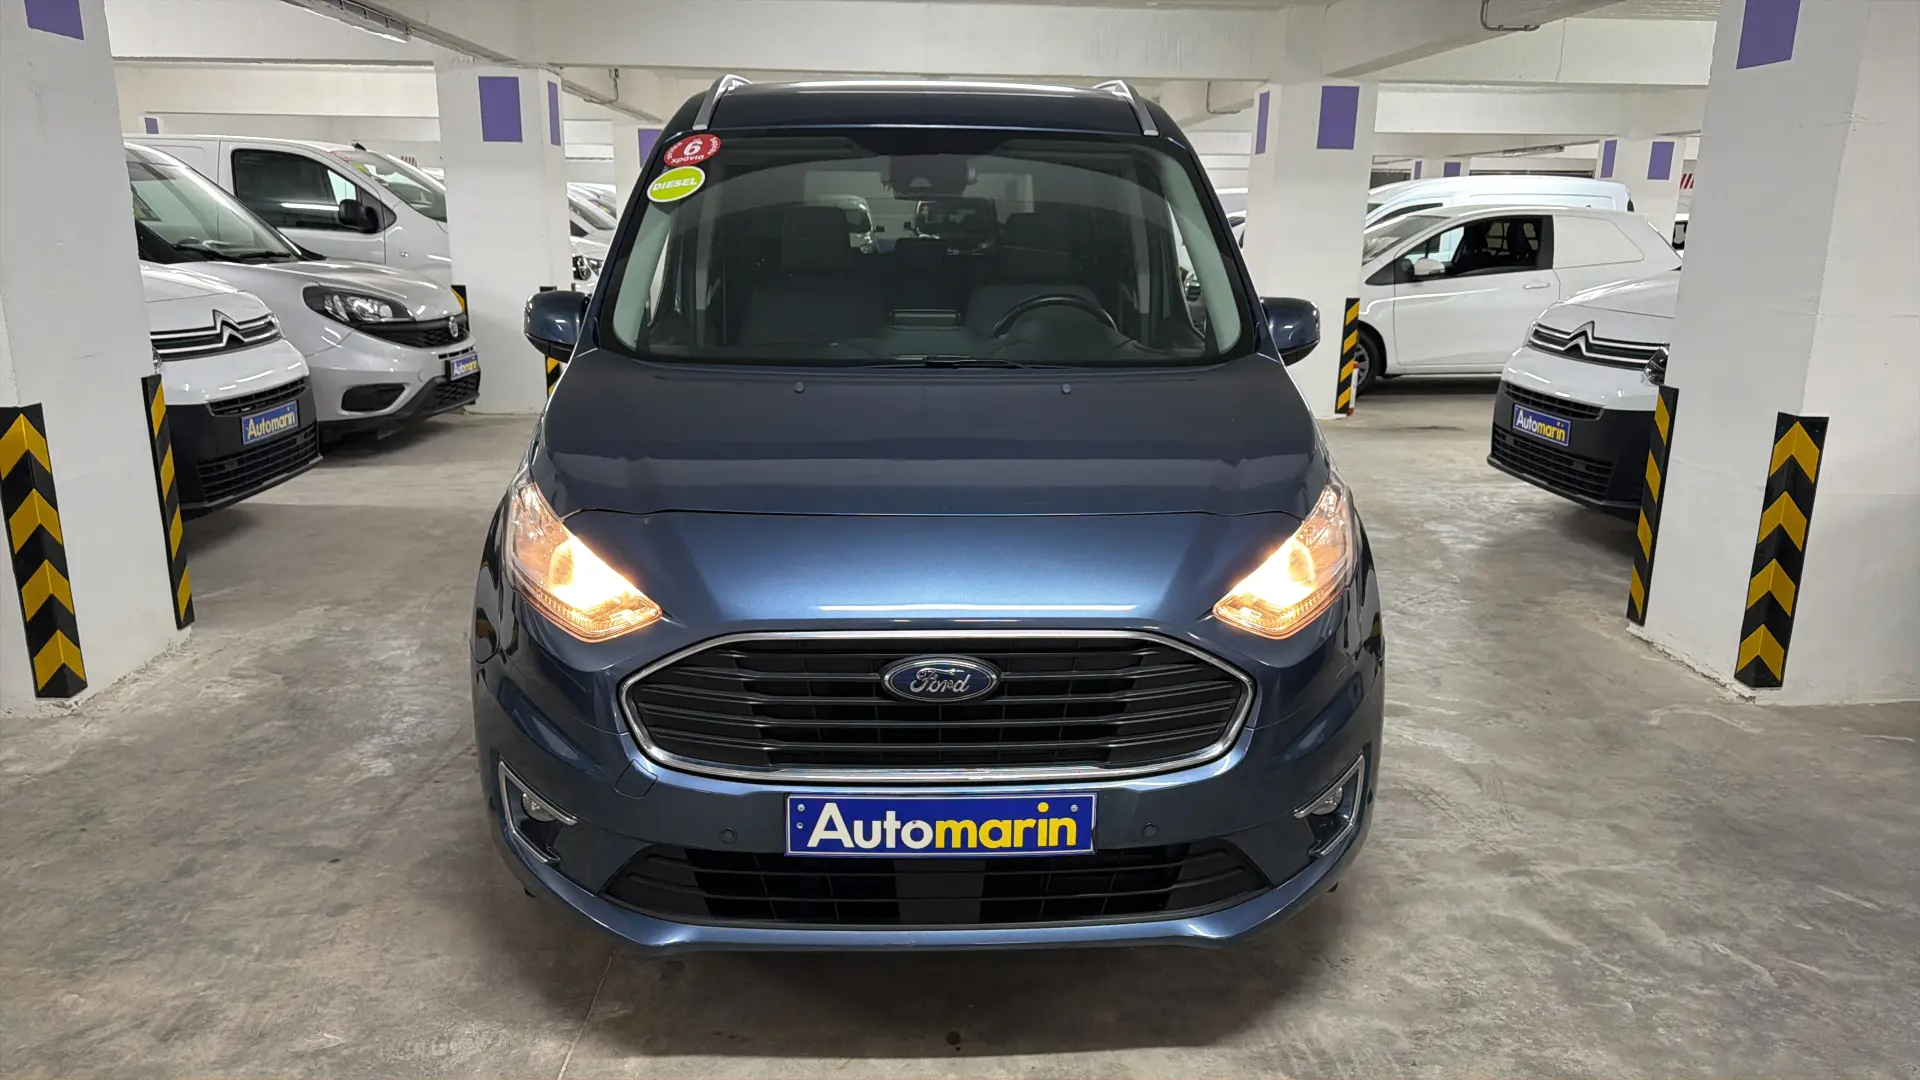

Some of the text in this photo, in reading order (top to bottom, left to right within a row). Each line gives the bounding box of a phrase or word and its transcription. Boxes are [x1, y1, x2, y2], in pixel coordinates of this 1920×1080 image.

[683, 141, 703, 156] 6
[653, 177, 698, 191] DIESEL
[247, 406, 296, 440] Automarin
[1515, 409, 1566, 442] Automarin
[910, 667, 970, 693] Ford
[806, 802, 1077, 849] Automarin
